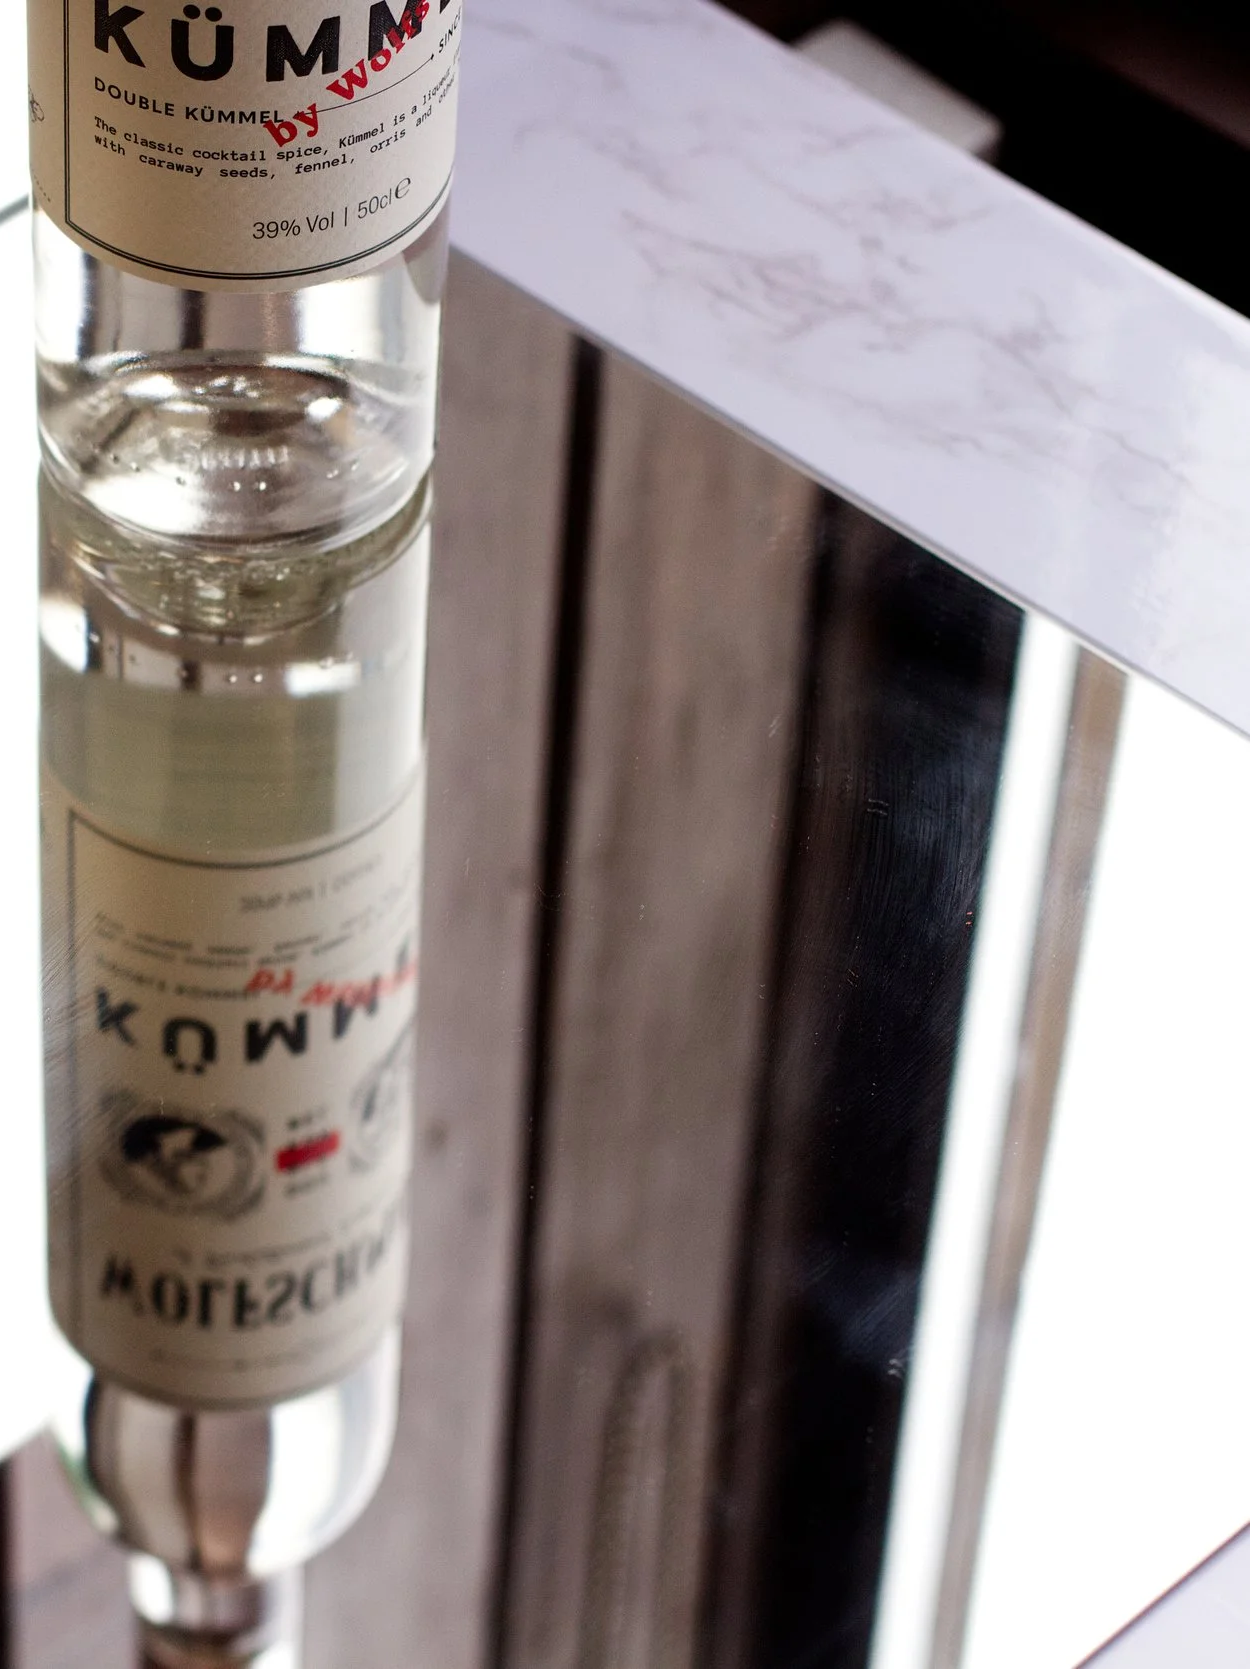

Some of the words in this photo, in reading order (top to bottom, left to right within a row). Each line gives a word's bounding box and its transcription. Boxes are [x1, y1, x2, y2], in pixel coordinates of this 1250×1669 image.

[94, 0, 452, 82] KÜMM
[94, 77, 175, 117] DOUBLE
[185, 105, 284, 125] KÜMMEL
[262, 103, 319, 148] by
[94, 116, 117, 136] The
[124, 131, 184, 156] classic
[192, 149, 267, 162] cocktail
[276, 145, 329, 162] spice,
[339, 123, 385, 149] Kümmel
[393, 113, 406, 127] is
[411, 105, 418, 115] a
[94, 134, 126, 156] with
[139, 154, 204, 178] caraway
[219, 166, 276, 180] seeds,
[295, 153, 356, 175] fennel,
[370, 129, 407, 154] orris
[415, 104, 433, 127] and
[252, 218, 301, 240] 39%
[306, 211, 335, 233] Vol
